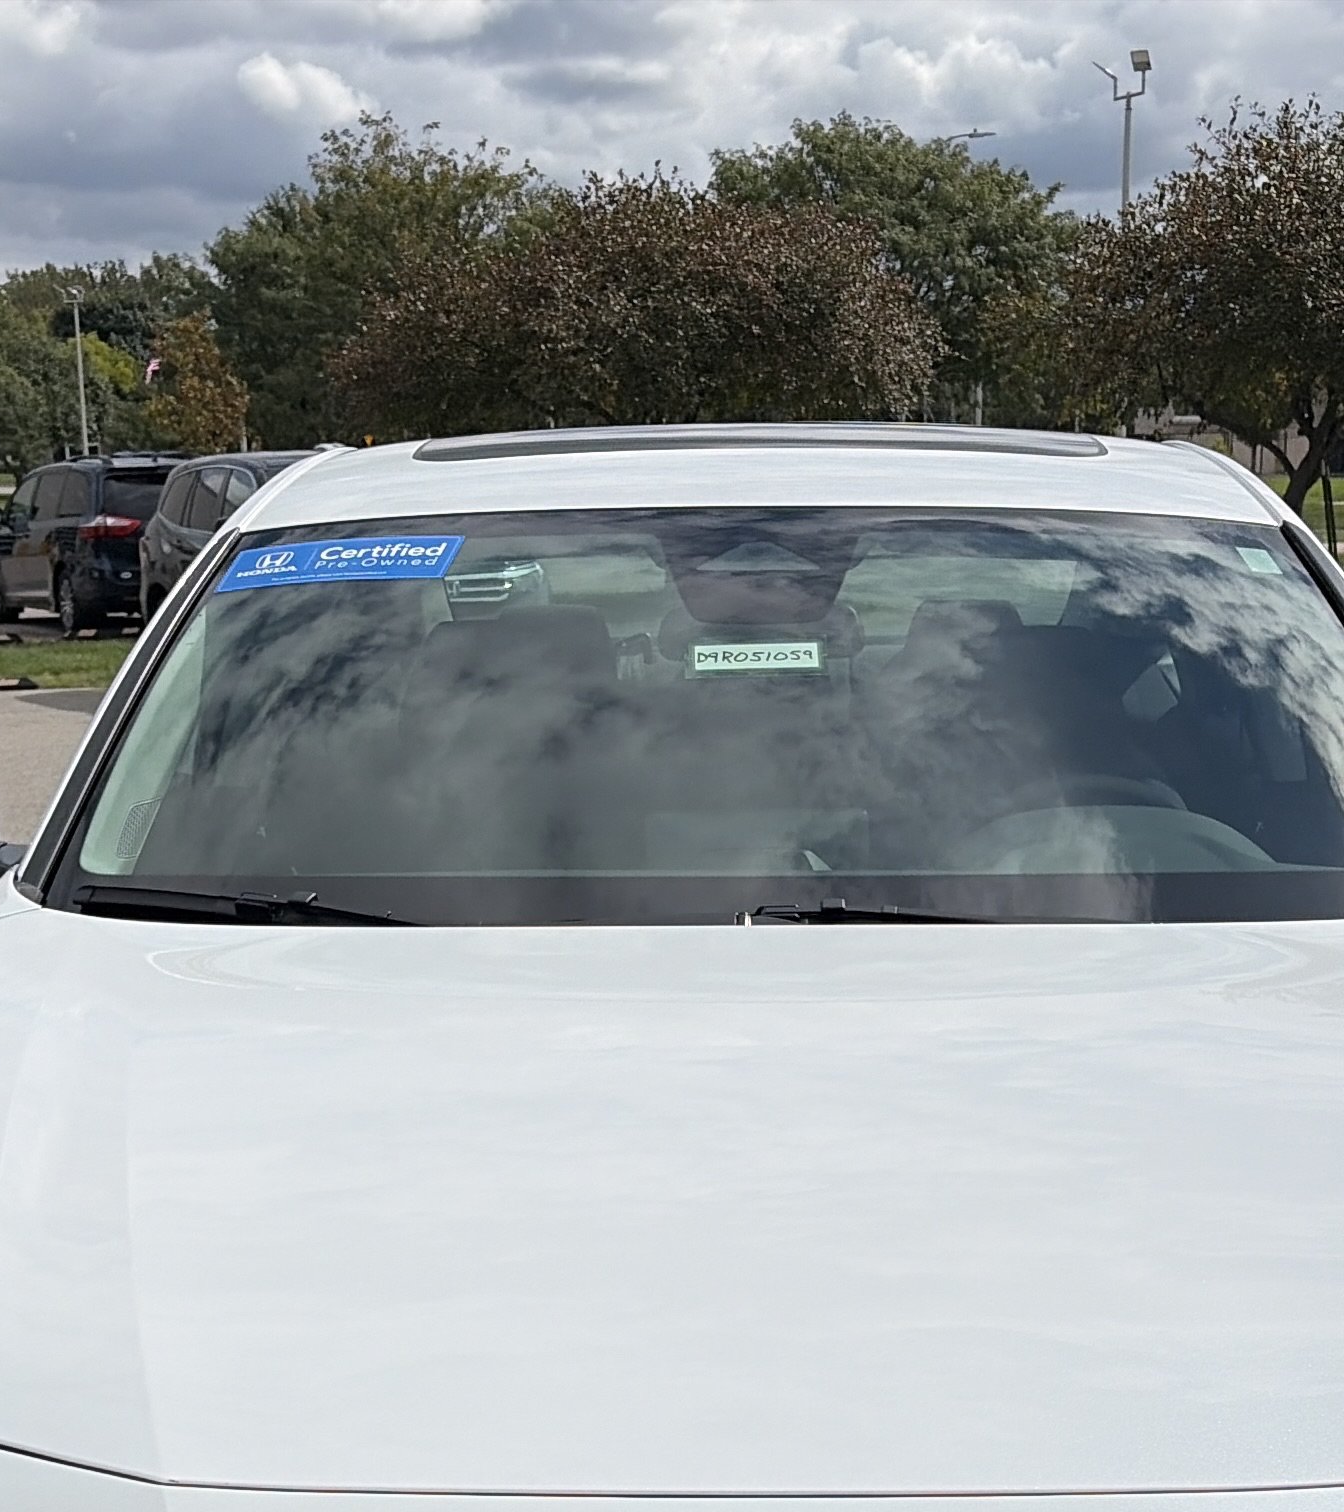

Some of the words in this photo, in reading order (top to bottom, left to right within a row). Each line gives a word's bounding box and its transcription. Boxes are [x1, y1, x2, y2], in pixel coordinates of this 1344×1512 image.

[320, 542, 448, 560] Certified
[314, 557, 439, 570] Pre-Owned
[236, 565, 297, 578] HONDA
